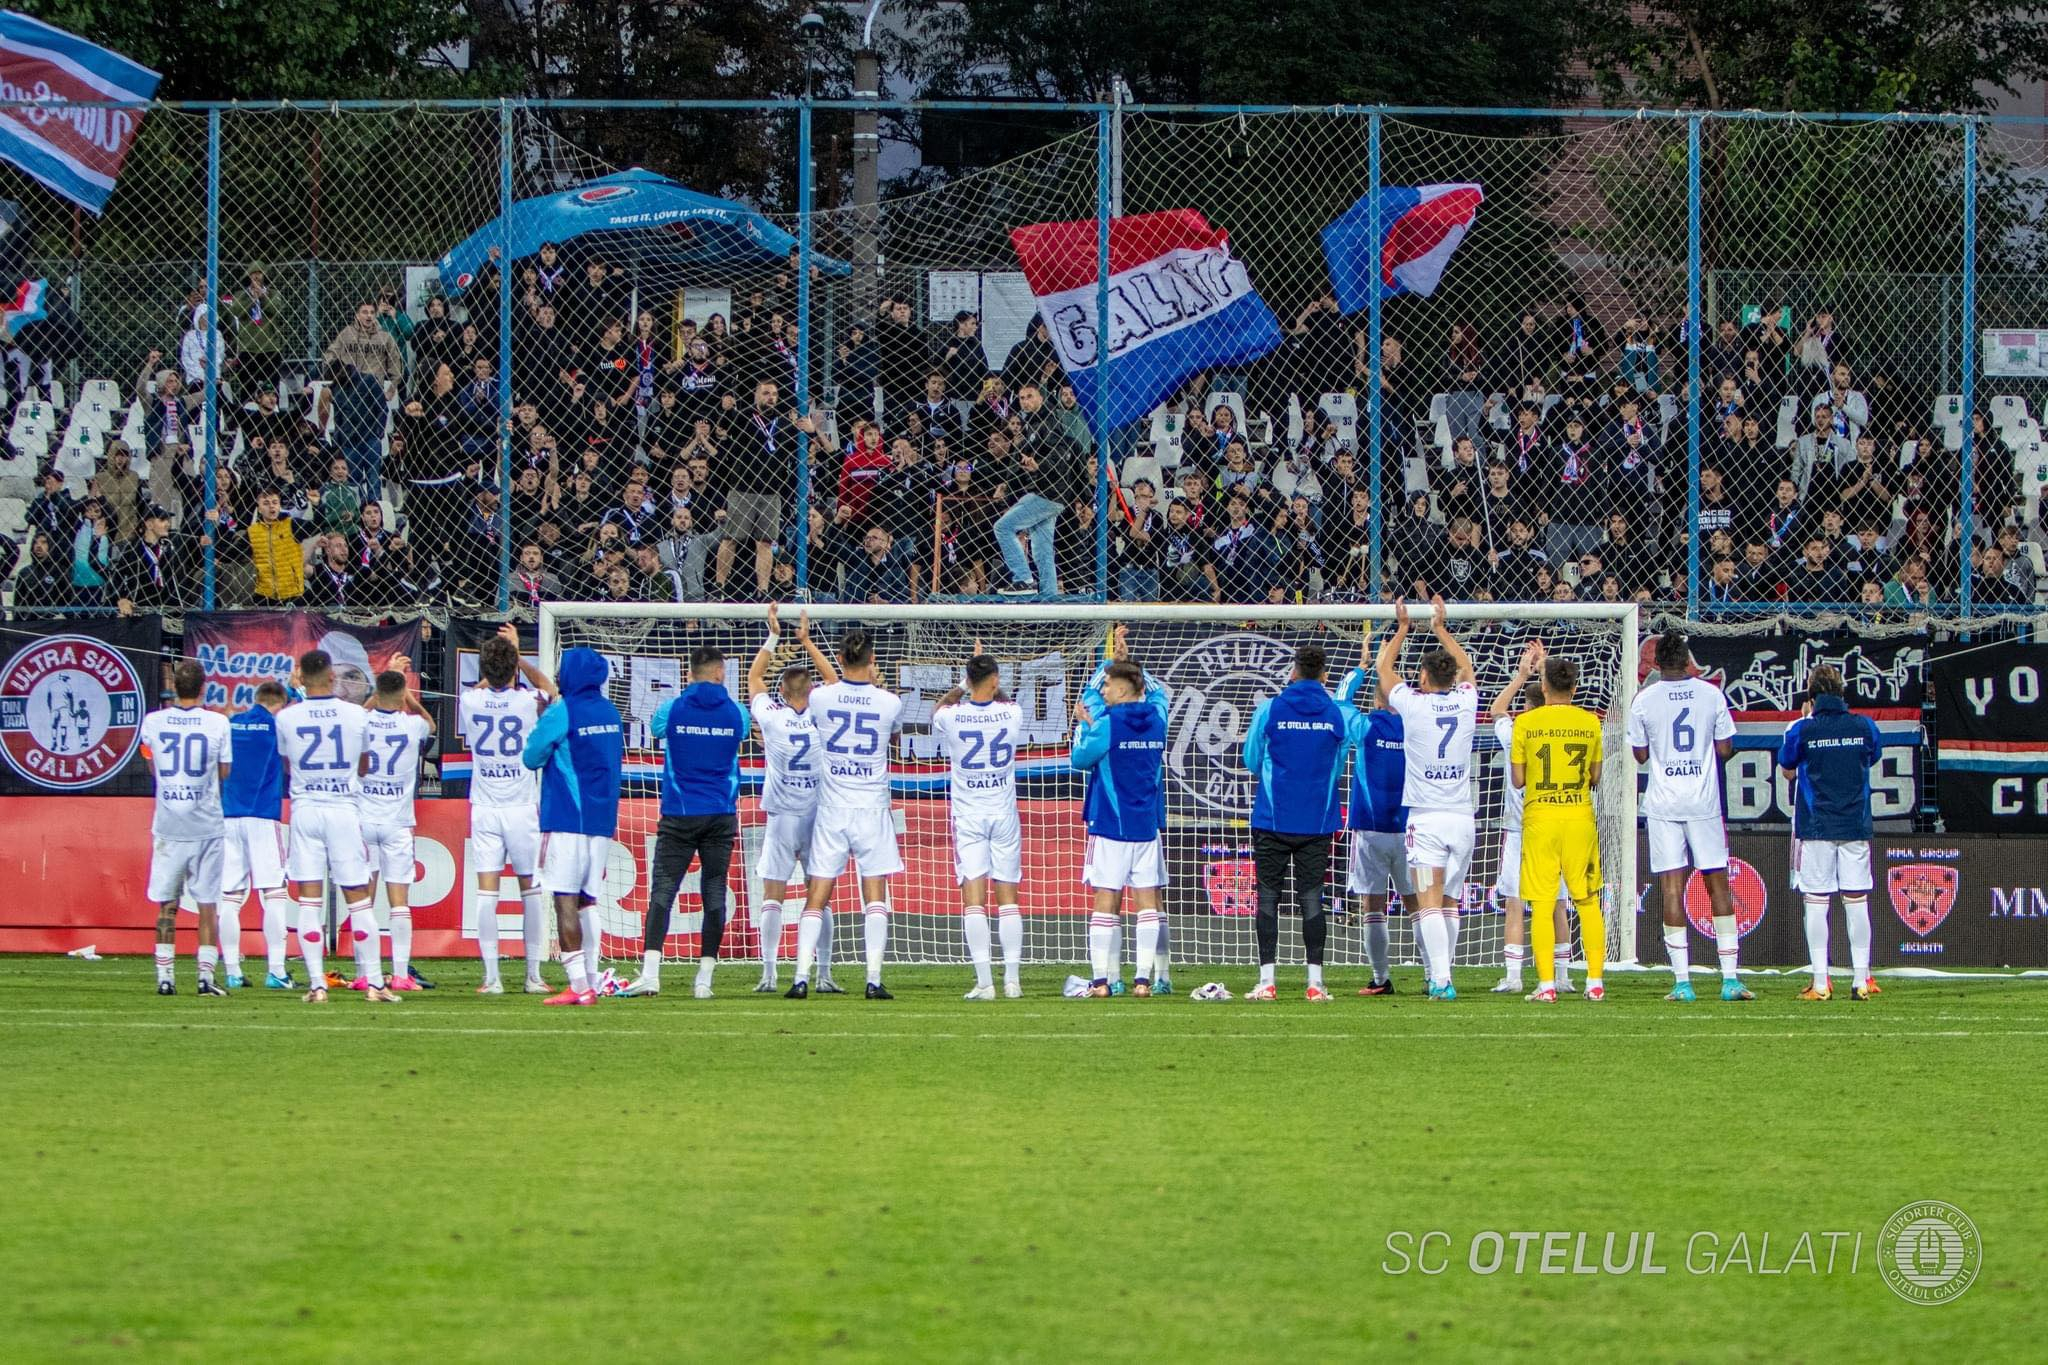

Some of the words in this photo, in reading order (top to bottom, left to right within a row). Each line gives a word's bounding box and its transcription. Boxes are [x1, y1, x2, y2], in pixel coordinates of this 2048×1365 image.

[610, 215, 639, 224] TASTE
[640, 214, 651, 222] IT.
[654, 211, 678, 221] LOVE
[679, 209, 690, 218] IT.
[693, 208, 714, 216] LIVE
[715, 208, 727, 219] IT.
[10, 646, 77, 691] ULTRA
[82, 650, 123, 686] SUD
[838, 694, 872, 706] LOVRIC
[1668, 690, 1694, 700] CISSE
[2, 701, 20, 713] DIN
[308, 709, 338, 718] TELES
[2, 714, 26, 728] TATA
[117, 711, 134, 724] FIU
[676, 725, 685, 734] SC
[686, 726, 710, 735] OTELUL
[826, 710, 880, 755] 25
[1278, 722, 1286, 730] SC
[1287, 722, 1311, 730] OTELUL
[1672, 708, 1695, 752] 6
[472, 714, 523, 756] 28
[1436, 716, 1458, 759] 7
[1808, 740, 1816, 748] SC
[1817, 738, 1840, 748] OTELUL
[1842, 737, 1864, 746] GALATI
[296, 724, 350, 770] 21
[958, 728, 1012, 770] 26
[1376, 739, 1384, 748] SC
[160, 732, 208, 777] 30
[788, 734, 811, 771] 2
[26, 744, 116, 778] GALATI
[1536, 743, 1588, 791] 13
[1920, 848, 1959, 858] GROUP
